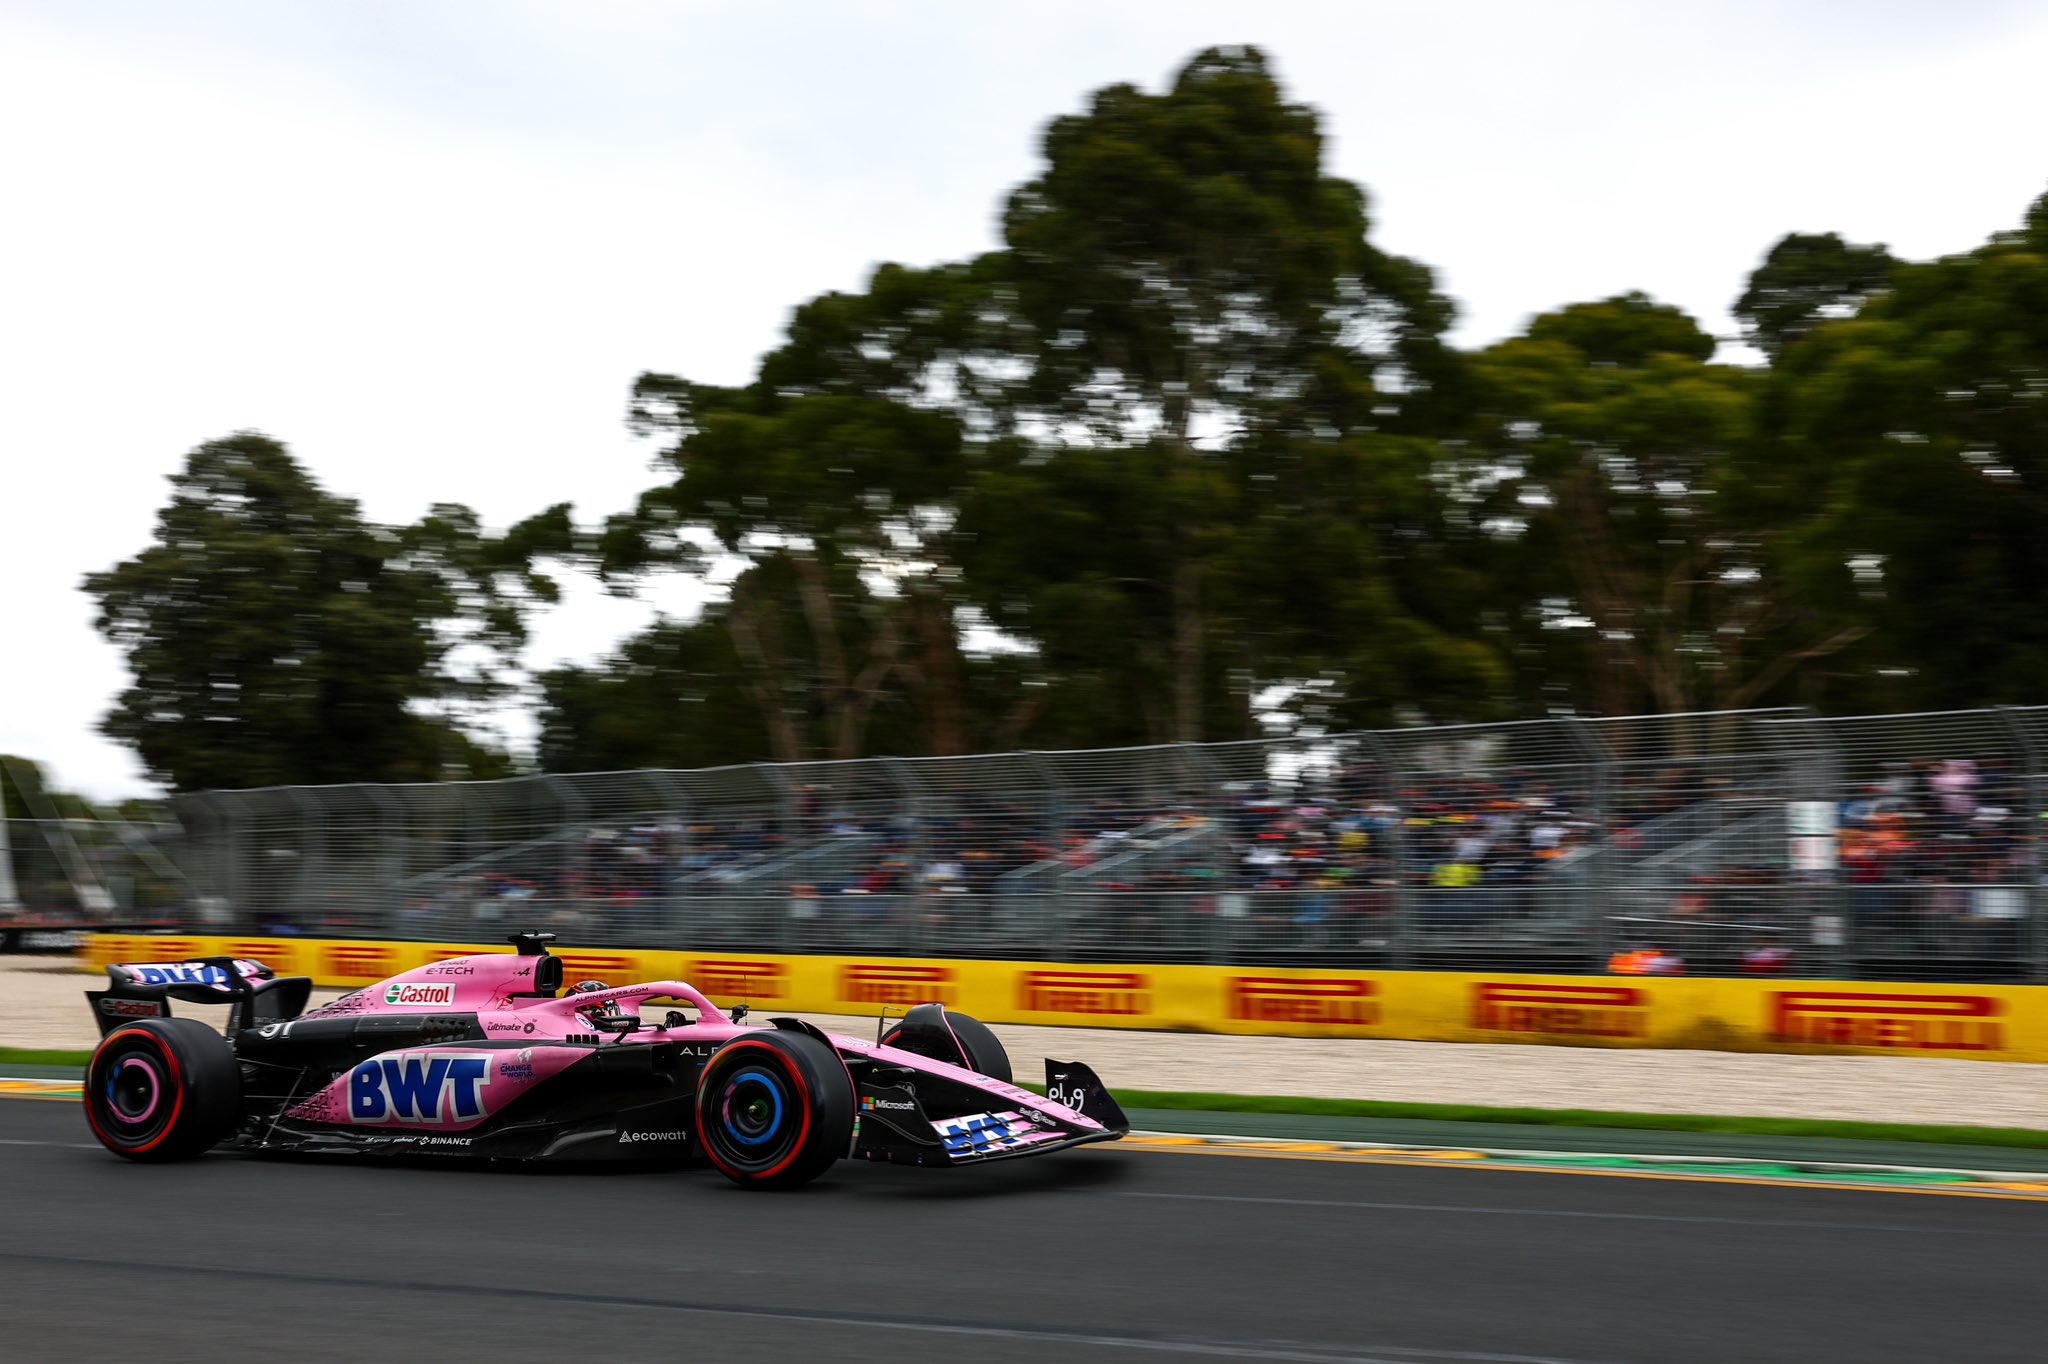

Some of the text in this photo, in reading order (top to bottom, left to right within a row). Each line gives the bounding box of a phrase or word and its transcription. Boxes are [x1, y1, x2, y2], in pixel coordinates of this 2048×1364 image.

[425, 967, 474, 975] E-TECH
[400, 985, 449, 1003] Castrol
[575, 987, 649, 1003] ALPINECARS.COM
[487, 1022, 521, 1032] ultimate
[500, 1064, 532, 1072] CHANGE
[350, 1055, 491, 1122] BWT
[1048, 1083, 1084, 1112] plug
[875, 1100, 915, 1110] Microsoft
[631, 1130, 686, 1141] ecowatt
[430, 1137, 472, 1145] BINANCE
